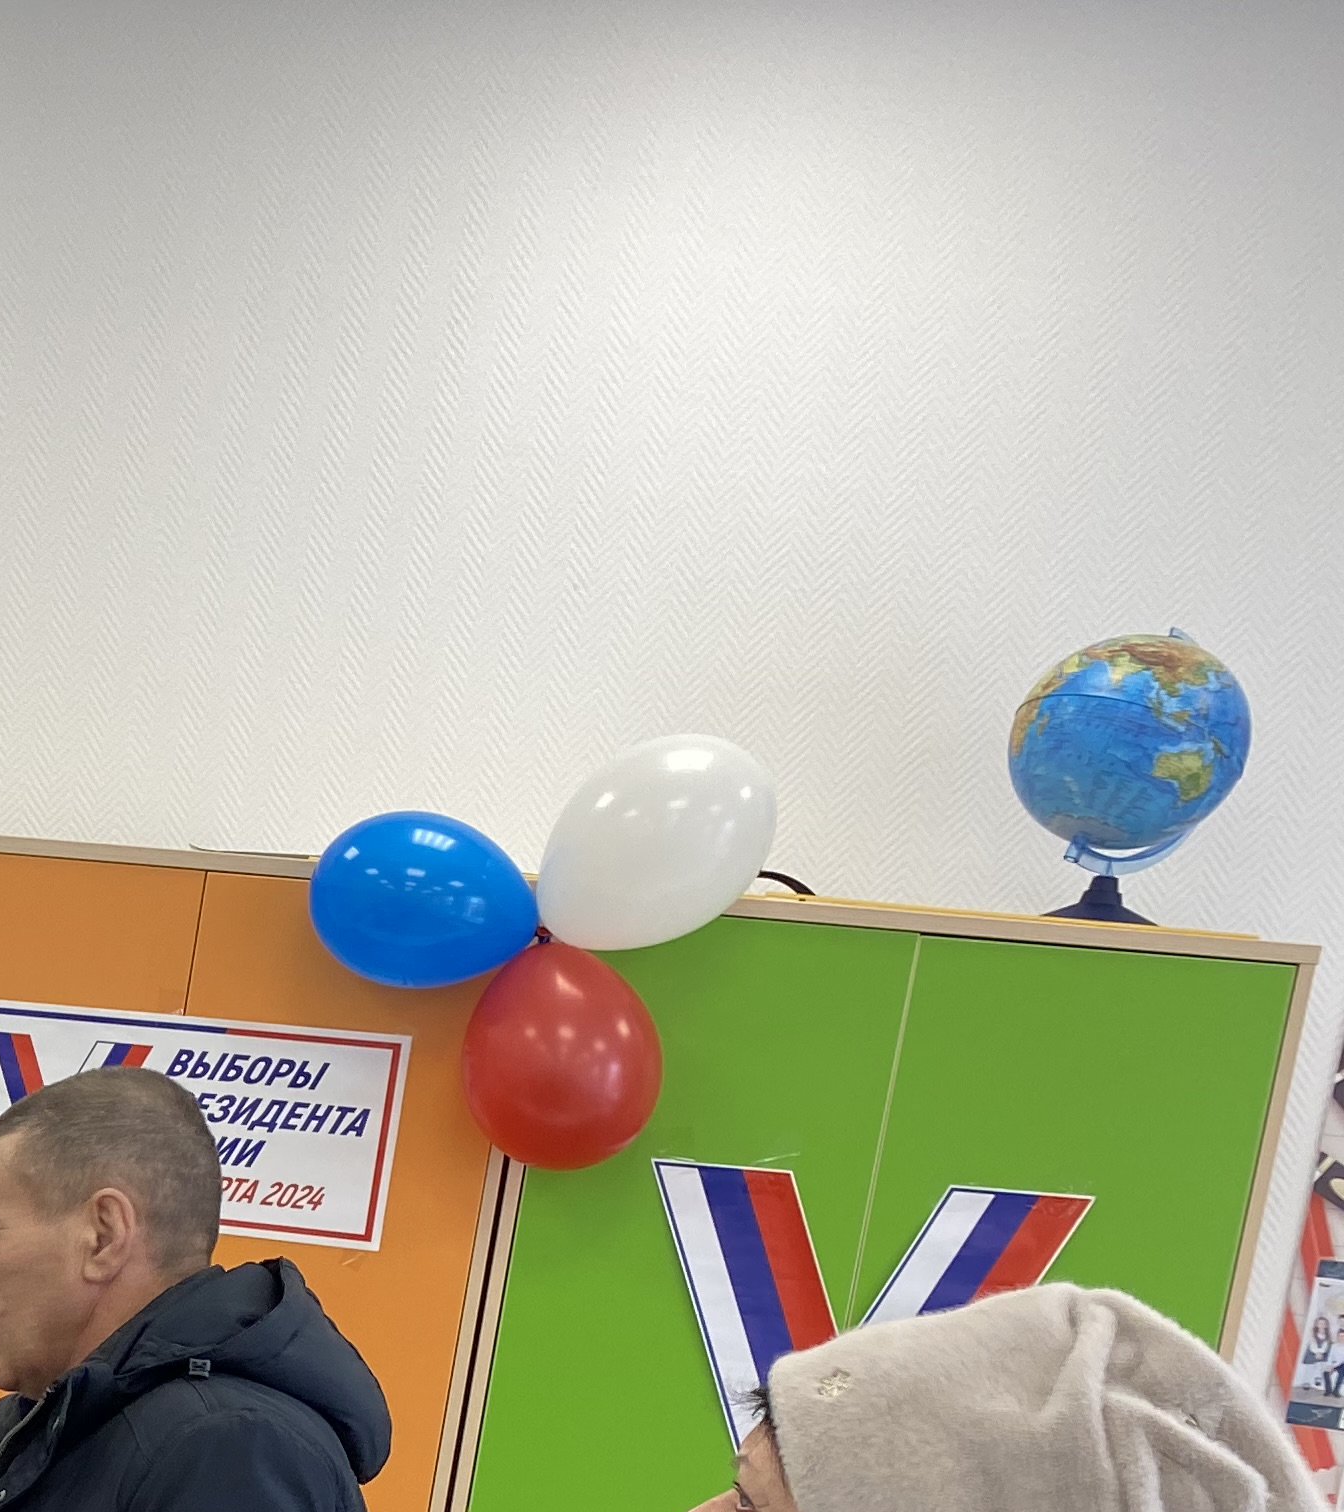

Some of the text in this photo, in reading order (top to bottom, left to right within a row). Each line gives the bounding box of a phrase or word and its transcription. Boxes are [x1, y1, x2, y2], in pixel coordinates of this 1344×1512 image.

[165, 1048, 329, 1092] ВЫБОРЫ
[197, 1090, 371, 1139] ЕЗИДЕНТА
[214, 1135, 267, 1169] ИИ
[260, 1181, 326, 1213] 2024
